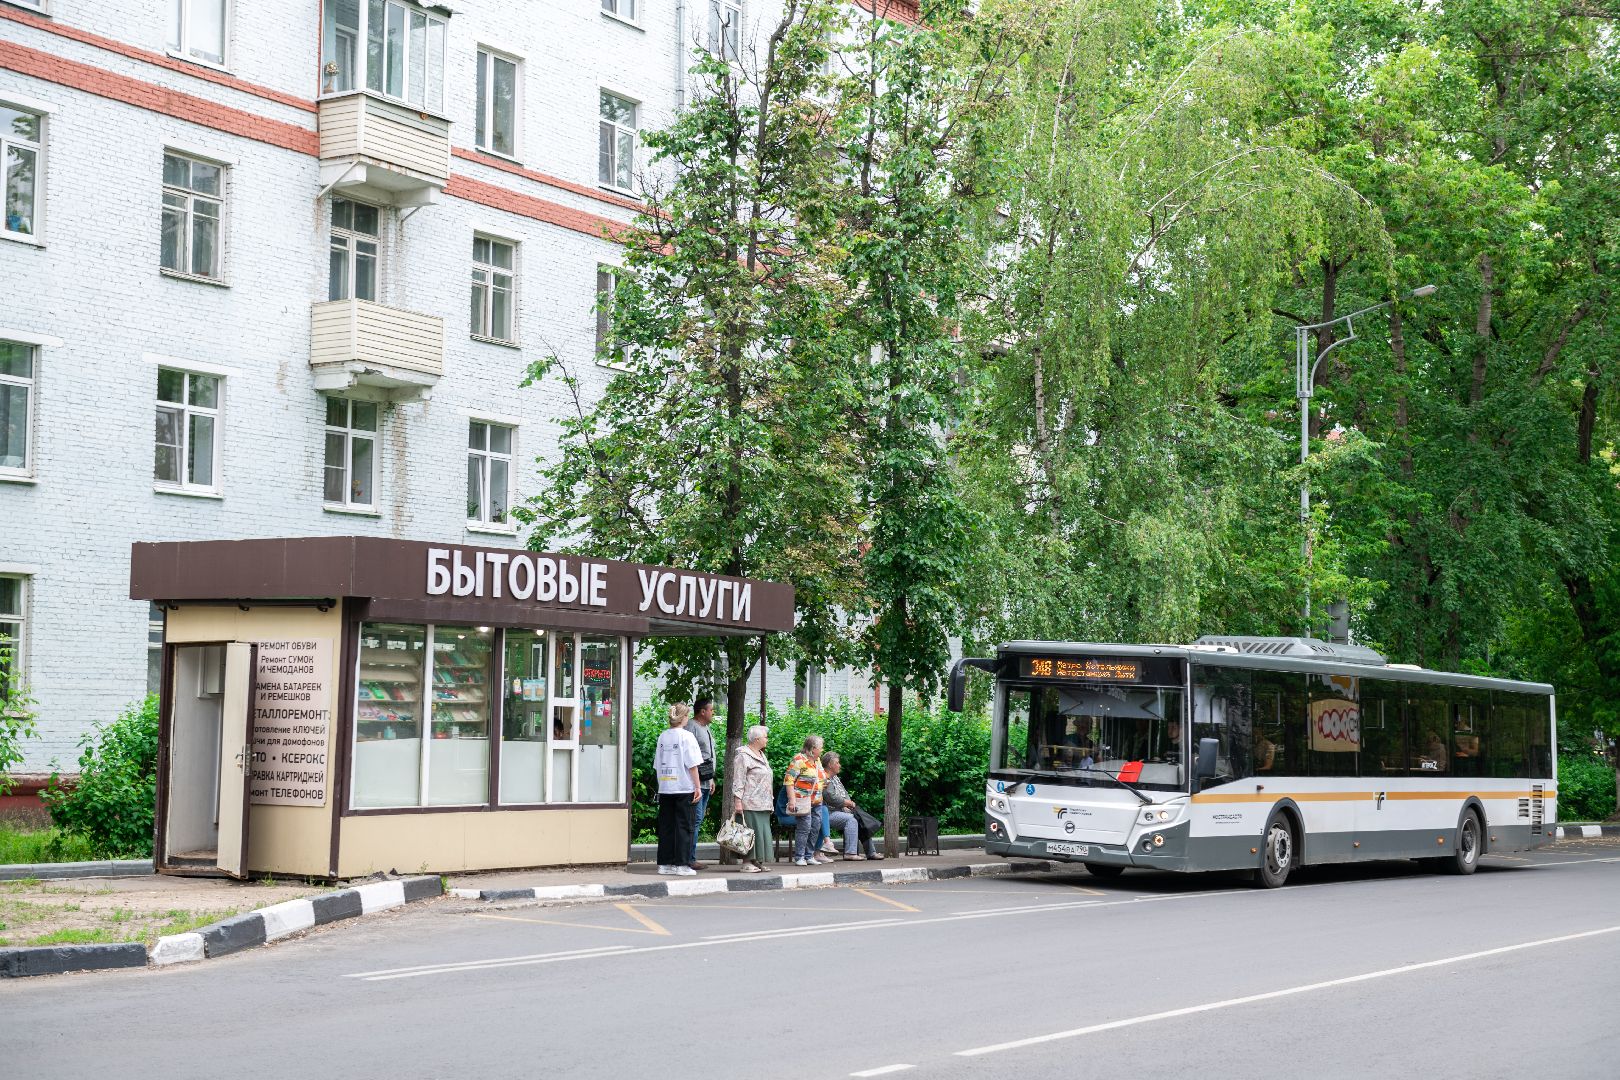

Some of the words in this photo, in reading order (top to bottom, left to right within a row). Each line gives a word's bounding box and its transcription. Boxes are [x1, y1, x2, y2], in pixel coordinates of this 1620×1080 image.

[427, 548, 608, 607] БЫТОВЫЕ
[637, 568, 752, 622] УСЛУГИ
[260, 641, 290, 650] РЕМОНТ
[291, 641, 317, 650] ОБУВИ
[261, 655, 286, 664] Ремонт
[288, 655, 314, 664] СУМОК
[260, 666, 266, 674] И
[267, 666, 314, 675] ЧЕМОДАНОВ
[256, 683, 282, 691] АМЕНА
[283, 683, 322, 692] БАТАРЕЕК
[268, 693, 311, 701] РЕМЕШКОВ
[254, 709, 328, 720] ТАЛЛОРЕМОНТ
[254, 726, 291, 734] отовление
[292, 724, 325, 735] КЛЮЧЕЙ
[282, 738, 325, 747] домофонов
[281, 752, 325, 764] КСЕРОКС
[253, 770, 275, 781] РАВКА
[276, 770, 324, 784] КАРТРИДЖЕЙ
[251, 789, 269, 797] монт
[270, 787, 324, 799] ТЕЛЕФОНОВ
